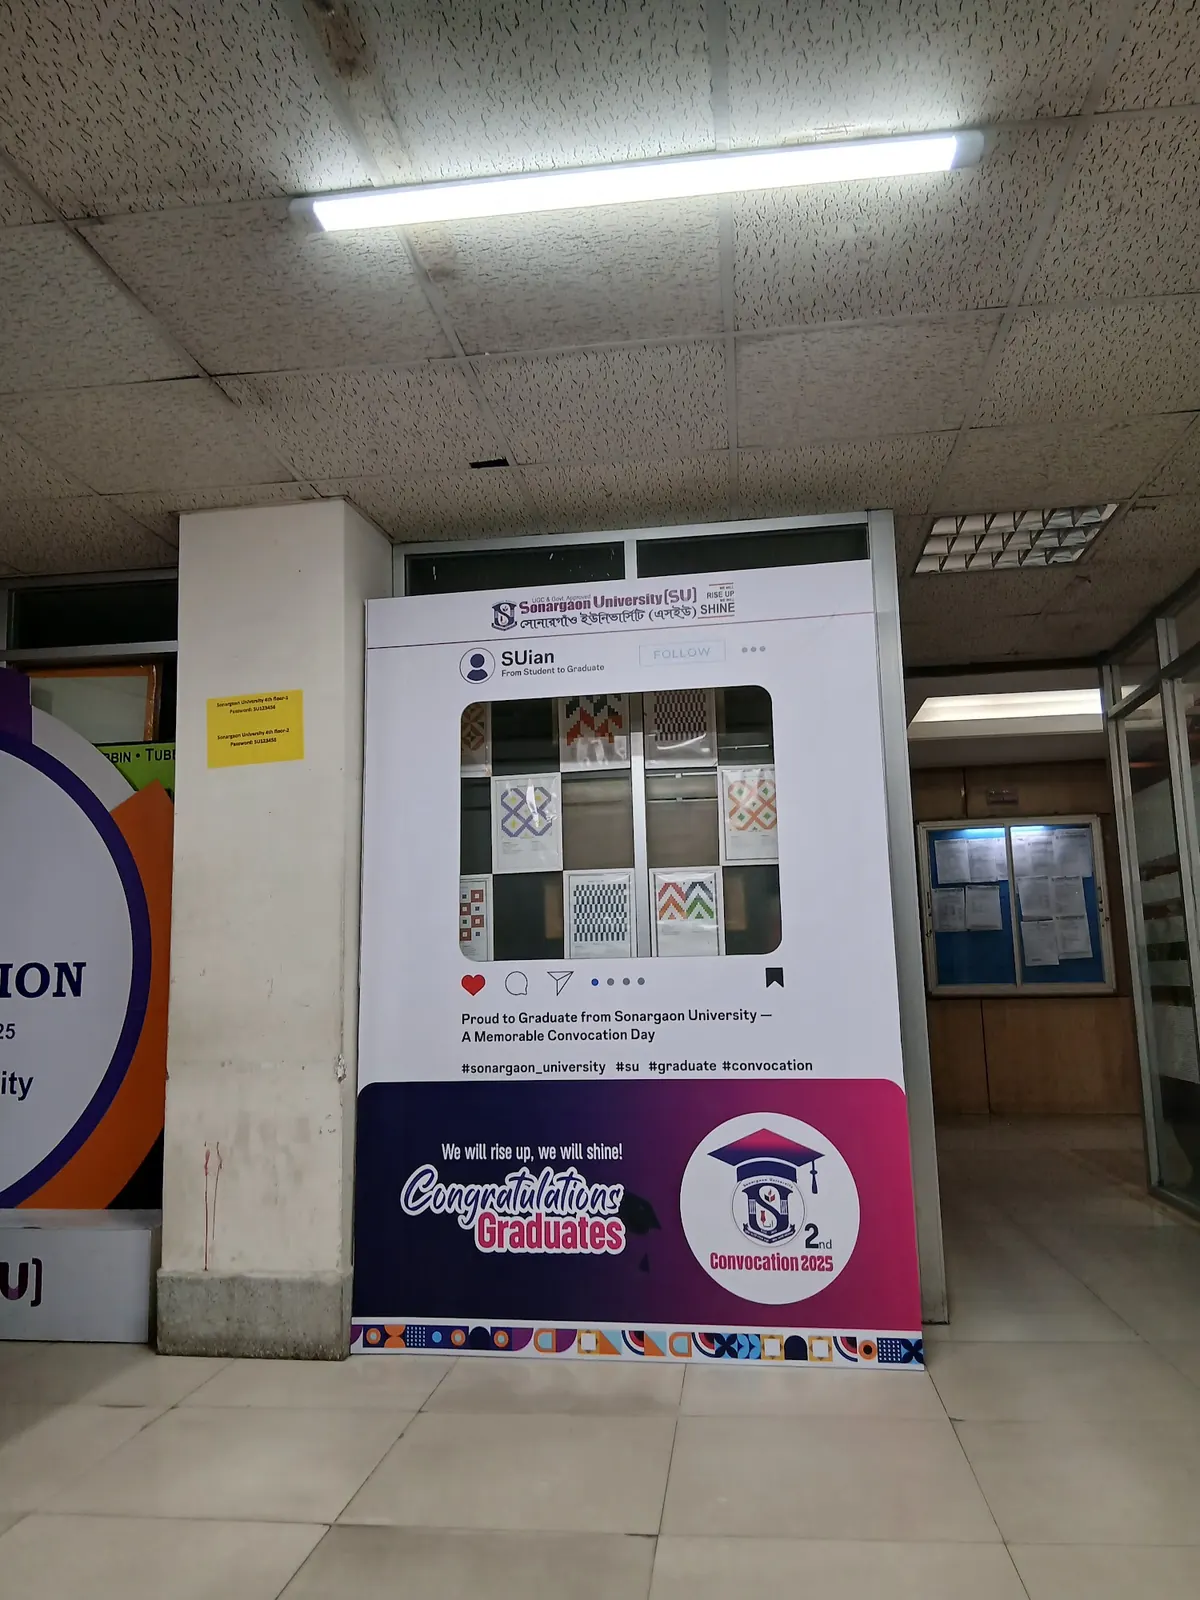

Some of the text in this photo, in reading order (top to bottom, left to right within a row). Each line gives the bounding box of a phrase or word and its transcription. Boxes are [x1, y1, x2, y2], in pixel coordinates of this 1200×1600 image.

[706, 591, 723, 599] RISE
[519, 600, 591, 614] Sonargaon
[593, 593, 663, 608] University
[700, 602, 735, 614] SHINE
[520, 605, 697, 629] সোনারগাঁও ইউনিভার্সিটি (এসইউ)
[501, 650, 555, 666] SUian
[653, 648, 711, 660] FOLLOW
[523, 667, 555, 676] Student
[567, 664, 604, 673] Graduate
[145, 748, 175, 761] TUB
[461, 1013, 499, 1024] Proud
[502, 1014, 515, 1024] to
[519, 1012, 578, 1023] Graduate
[581, 1011, 611, 1022] from
[614, 1010, 684, 1024] Sonargaon
[688, 1009, 757, 1023] University
[461, 1029, 655, 1043] A Memorable Convocation Day
[461, 1059, 812, 1076] #sonargaon_university #su #graduate #convocation
[1, 1071, 34, 1101] ity
[441, 1143, 623, 1162] We will rise up, we will shine!
[402, 1166, 622, 1228] Congratulations
[477, 1212, 623, 1250] Graduates
[710, 1252, 833, 1272] Convocation 2025
